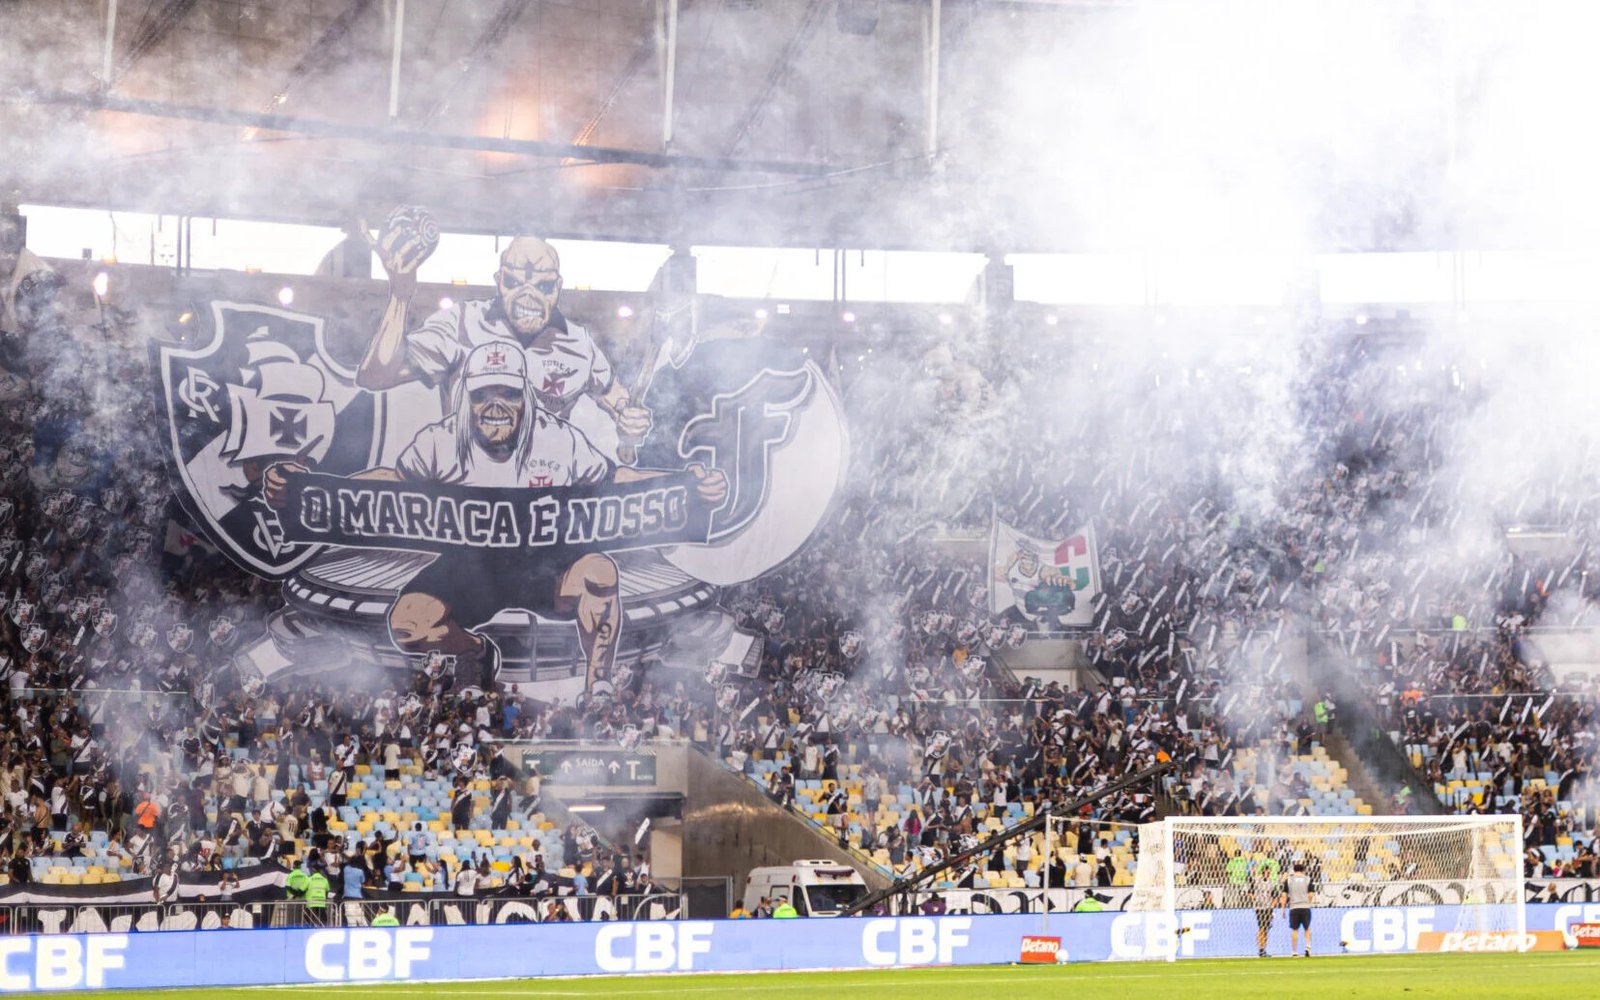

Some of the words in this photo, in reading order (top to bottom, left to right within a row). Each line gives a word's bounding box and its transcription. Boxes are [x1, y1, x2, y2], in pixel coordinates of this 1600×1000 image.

[301, 486, 331, 532] O
[338, 489, 521, 547] MARACA
[528, 494, 560, 546] É
[565, 485, 688, 543] NOSSO
[595, 921, 715, 972] CBF
[861, 917, 972, 965] CBF
[1021, 938, 1060, 954] Betano
[1110, 911, 1213, 958] CBF
[1340, 907, 1436, 952] CBF
[1440, 931, 1538, 952] Betano
[0, 936, 129, 990] CBF
[305, 928, 434, 980] CBF
